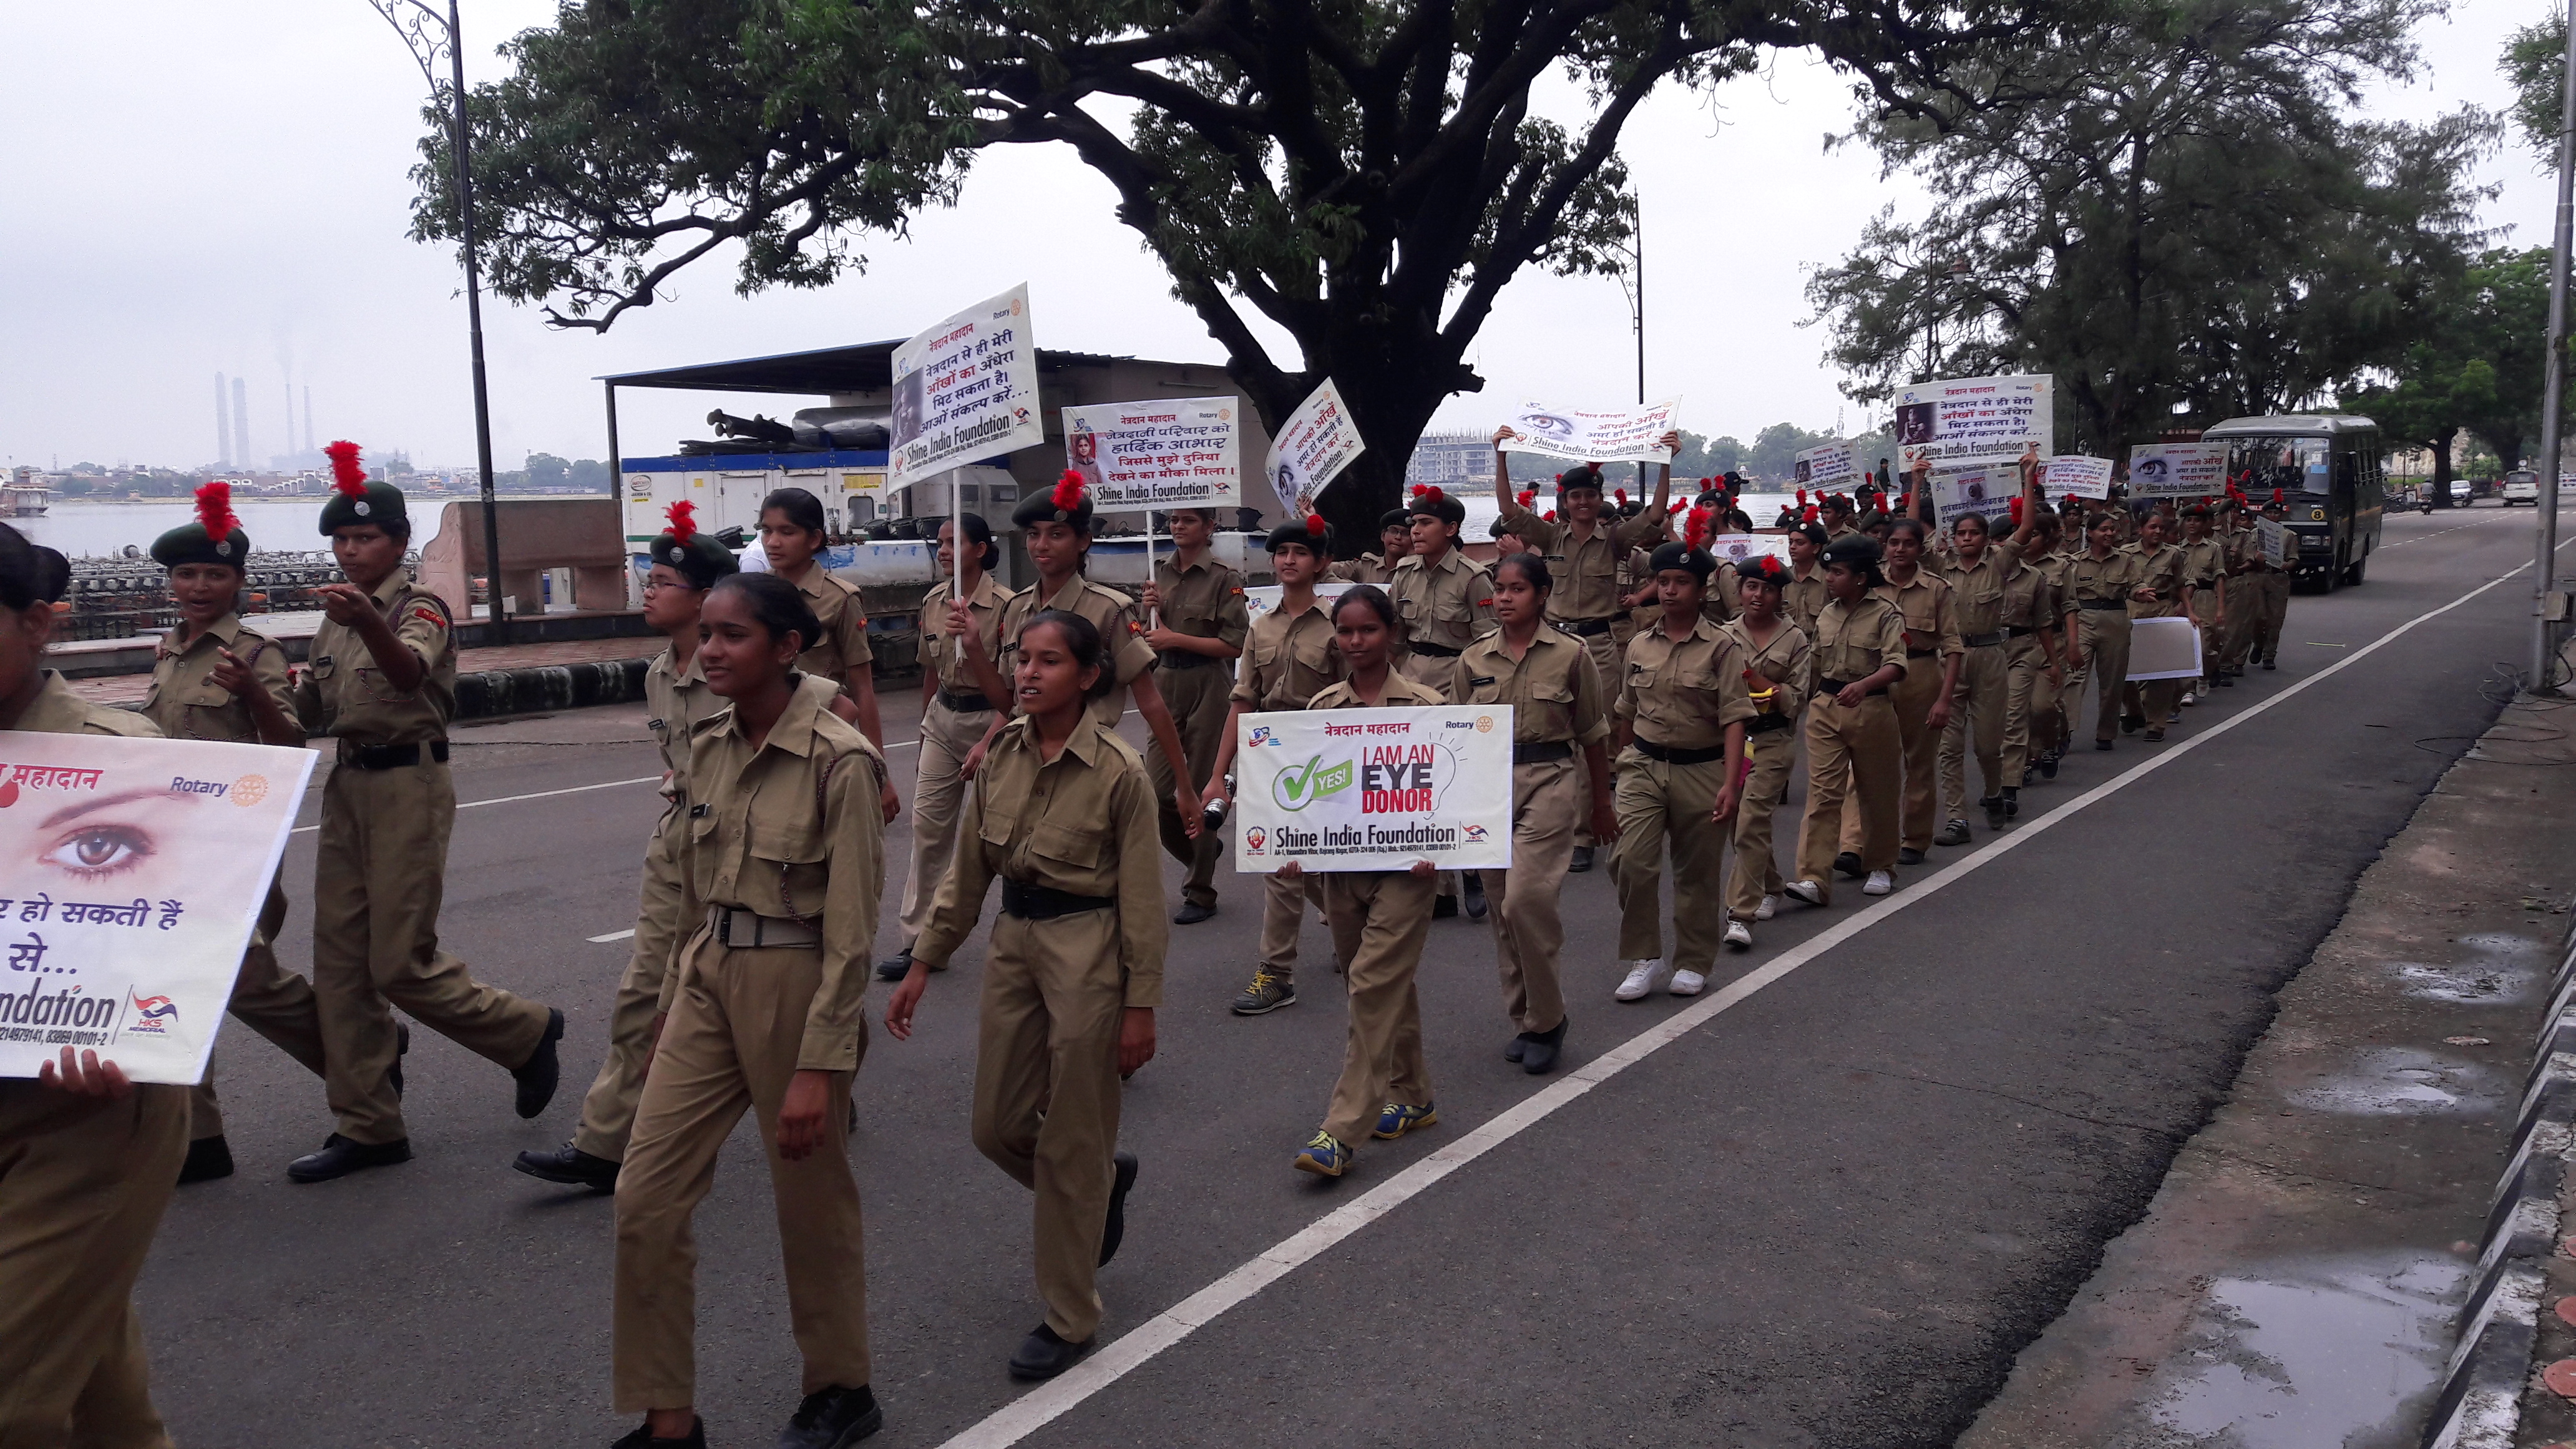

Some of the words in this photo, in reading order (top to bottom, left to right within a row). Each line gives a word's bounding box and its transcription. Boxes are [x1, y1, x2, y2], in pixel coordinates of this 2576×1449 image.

[950, 323, 973, 341] महादान
[925, 354, 959, 377] नेत्रदान
[961, 346, 972, 361] से
[975, 339, 988, 355] ही
[991, 329, 1013, 347] मेरी
[927, 369, 956, 396] आँखों
[959, 364, 975, 379] का
[980, 350, 1015, 371] अँधेरा
[932, 393, 952, 410] मिट
[955, 377, 990, 399] सकता
[1940, 401, 1978, 409] नेत्रदान
[1981, 398, 1993, 406] से
[1996, 398, 2010, 406] ही
[2012, 397, 2034, 406] मेरी
[950, 398, 987, 419] संकल्प
[1121, 415, 1146, 425] नेत्रदान
[1147, 414, 1176, 422] महादान
[1159, 425, 1209, 436] परिवार
[1211, 422, 1232, 433] को
[907, 443, 928, 465] Shine
[930, 431, 951, 454] India
[954, 413, 1010, 446] Foundation
[1295, 426, 1315, 451] आपकी
[1968, 429, 2007, 437] संकल्प
[1111, 439, 1165, 454] हार्दिक
[1168, 437, 1227, 450] आभार
[1297, 449, 1310, 466] अमर
[1309, 441, 1317, 452] हो
[1316, 422, 1337, 444] सकती
[1534, 437, 1559, 449] Shine
[1562, 443, 1587, 454] India
[1591, 443, 1644, 456] Foundation
[1945, 443, 1968, 454] India
[1971, 439, 2023, 452] Foundation
[1118, 454, 1154, 467] जिससे
[1183, 451, 1221, 466] दुनिया
[1304, 447, 1327, 471] नेत्रदान
[1310, 450, 1343, 485] Foundation
[1108, 471, 1136, 483] देखने
[1139, 471, 1155, 480] का
[1193, 466, 1226, 477] मिला
[1097, 484, 1123, 500] Shine
[1126, 482, 1149, 498] India
[1153, 481, 1209, 497] Foundation
[1324, 722, 1364, 737] नेत्रदान
[1366, 723, 1411, 735] महादान
[1445, 721, 1474, 729] Rotary
[1363, 746, 1367, 766] I
[1372, 745, 1403, 766] AM
[1407, 744, 1434, 764] AN
[11, 765, 104, 790] महादान
[170, 777, 228, 797] Rotary
[1317, 768, 1346, 791] YES!
[1362, 763, 1433, 791] EYE
[1362, 788, 1432, 814] DONOR
[1276, 825, 1318, 848] Shine
[1324, 824, 1362, 847] India
[1368, 822, 1455, 845] Foundation
[20, 892, 53, 922] हो
[62, 897, 151, 927] सकती
[157, 899, 183, 930] हैं
[138, 1019, 163, 1027] HKS
[72, 1033, 107, 1045] 00101-2
